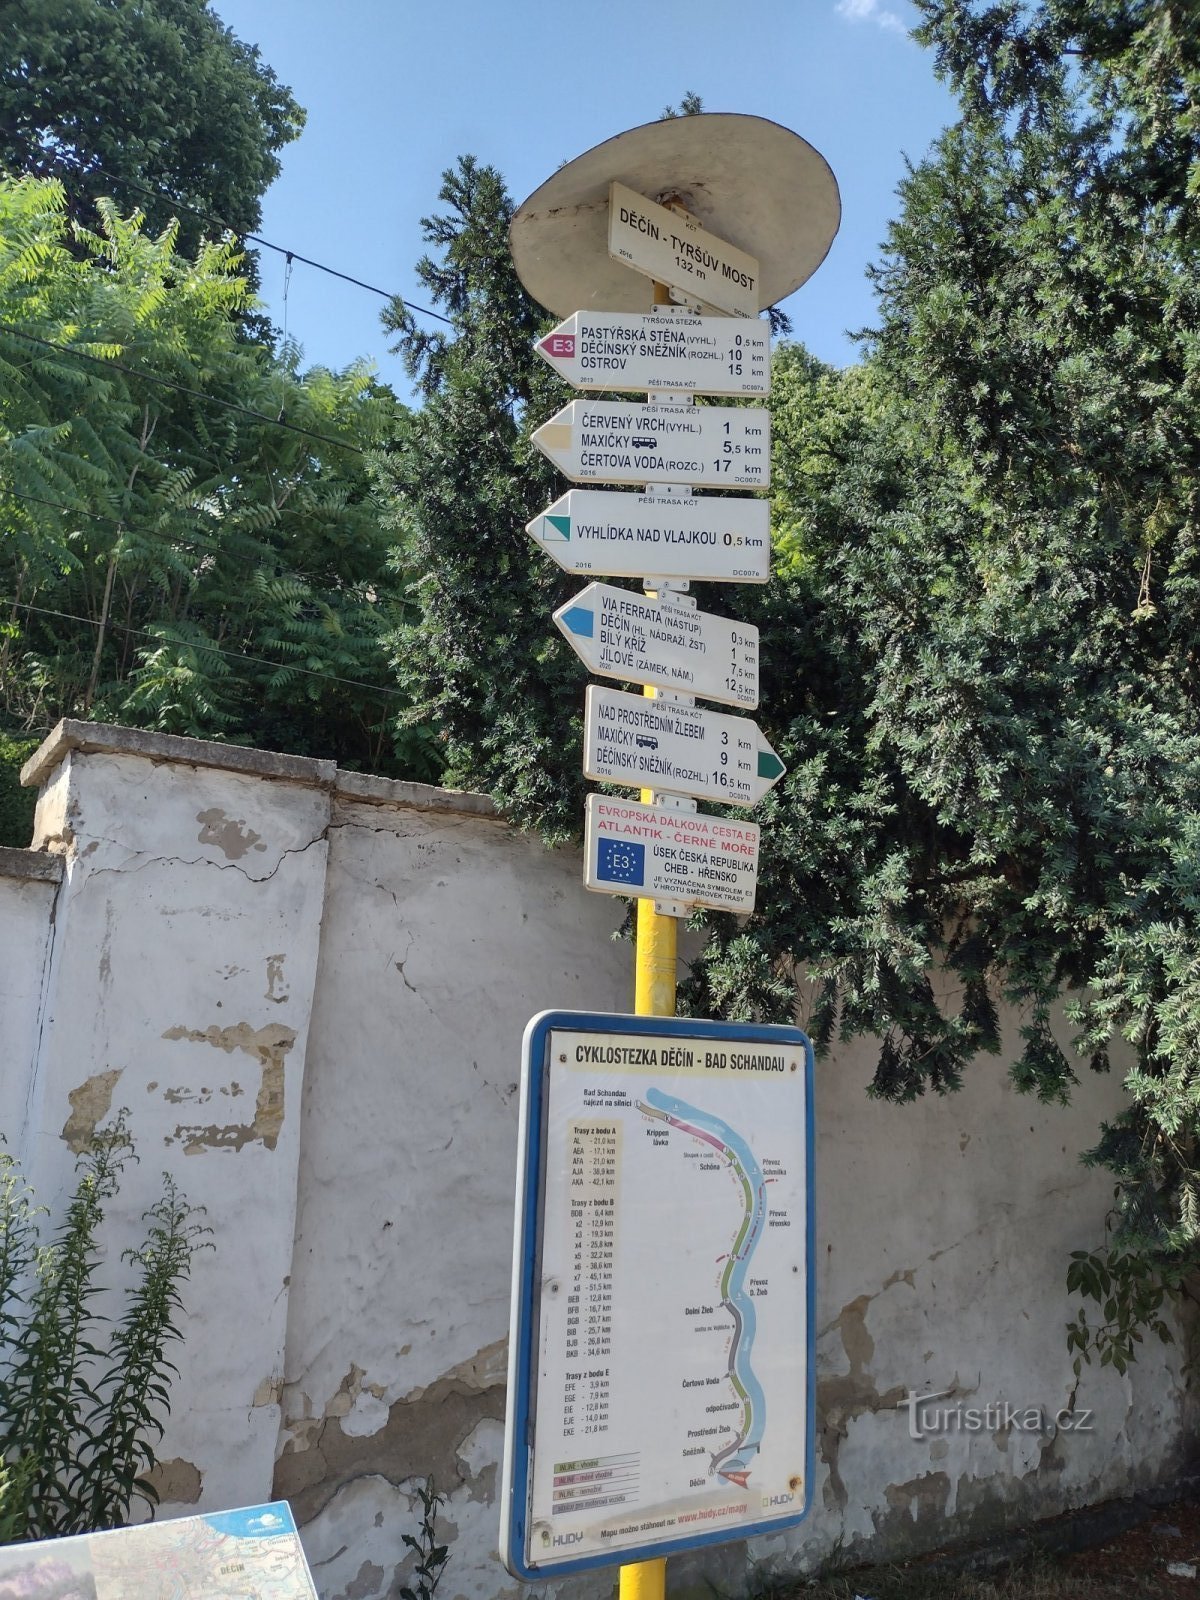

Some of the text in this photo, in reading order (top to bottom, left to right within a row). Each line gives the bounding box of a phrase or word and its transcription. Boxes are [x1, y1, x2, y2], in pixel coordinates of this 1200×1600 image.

[620, 208, 754, 291] DĚČÍN TYRŠŮV MOST
[676, 257, 706, 280] 132 m
[642, 317, 702, 326] TYRŠOVA STEZKA
[553, 340, 573, 352] E3
[581, 326, 646, 341] PASTÝŘSKÁ
[735, 335, 750, 347] 0,5
[752, 339, 764, 347] km
[581, 341, 636, 357] DĚČÍNSKÝ
[729, 350, 742, 360] 10
[581, 356, 626, 369] OSTROV
[728, 364, 742, 375] 15
[686, 380, 696, 388] KČT
[686, 407, 700, 415] KČT
[582, 412, 632, 429] ČERVENÝ
[724, 422, 730, 434] 1
[745, 427, 761, 436] km
[581, 433, 761, 454] MAXIČKY 5,5 km
[581, 451, 631, 467] ČERTOVA
[713, 460, 731, 472] 17
[745, 464, 761, 474] km
[657, 498, 681, 506] TRASA
[577, 524, 762, 546] VYHLÍDKA NAD VLAJKOU 0,5 km
[602, 596, 755, 648] VIA FERRATA (NÁSTUP) 0,3 km
[674, 608, 691, 618] TRASA
[601, 613, 630, 632] DĚČÍN
[632, 625, 647, 637] (HL.
[689, 640, 707, 653] ŽST)
[745, 654, 755, 664] km
[600, 630, 755, 680] BÍLÝ KŘÍŽ 7,5 km
[600, 647, 633, 667] JÍLOVÉ
[672, 668, 693, 683] NÁM.)
[725, 678, 743, 693] 12,5
[745, 686, 755, 696] km
[652, 703, 702, 719] PĚŠÍ TRASA KČT
[598, 704, 751, 750] NAD PROSTŘEDNÍM ŽLEBEM 3 km
[598, 726, 751, 771] MAXIČKY 9 km
[597, 747, 637, 769] DĚČÍNSKÝ
[712, 771, 734, 787] 16,5
[738, 780, 750, 791] km
[597, 767, 611, 776] 2016
[598, 805, 756, 842] EVROPSKÁ DÁLKOVÁ CESTA E3
[598, 821, 755, 856] ATLANTIK ČERNÉ MOŘE
[613, 854, 629, 869] E3
[653, 844, 754, 873] ÚSEK ČESKÁ REPUBLIKA
[664, 863, 737, 883] CHEB HŘENSKO
[660, 884, 745, 903] HROTU SMĚROVEK TRASY
[664, 877, 705, 890] VYZNAČENA
[707, 883, 742, 895] SYMBOLEM
[576, 1045, 785, 1072] CYKLOSTEZKA DĚČÍN BAD SCHANDAU
[614, 1099, 632, 1107] silnici
[574, 1127, 589, 1135] Trasy
[596, 1127, 610, 1135] bodu
[647, 1129, 669, 1137] Krippen
[566, 1372, 581, 1380] Trasy
[601, 1529, 618, 1538] Mapu
[619, 1526, 639, 1536] možno
[640, 1519, 665, 1531] stáhnout
[678, 1503, 748, 1524] www.hudy.cz/mapy
[552, 1531, 584, 1546] HUDY
